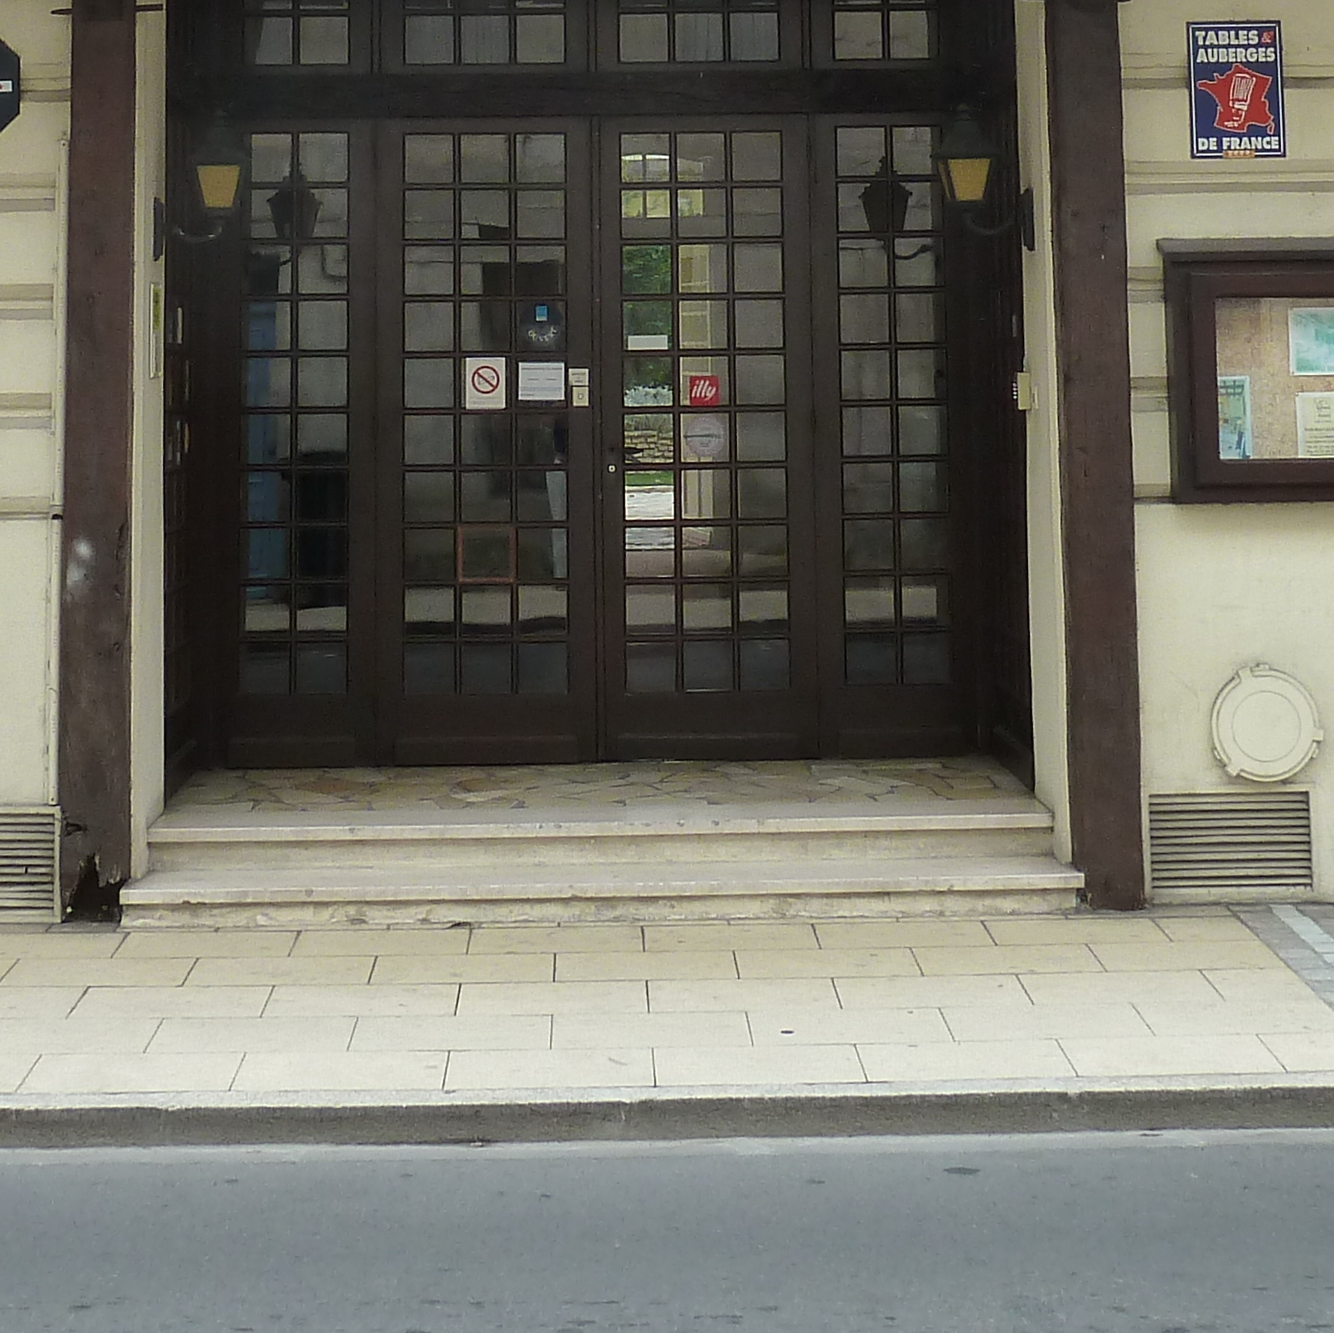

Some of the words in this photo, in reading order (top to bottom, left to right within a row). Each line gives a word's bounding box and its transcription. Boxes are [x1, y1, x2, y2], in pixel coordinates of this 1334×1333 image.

[1195, 30, 1259, 45] TABLES
[1196, 47, 1276, 63] AUBERGES
[1197, 137, 1218, 150] DE
[1222, 136, 1280, 150] FRANCE
[691, 380, 717, 401] illy
